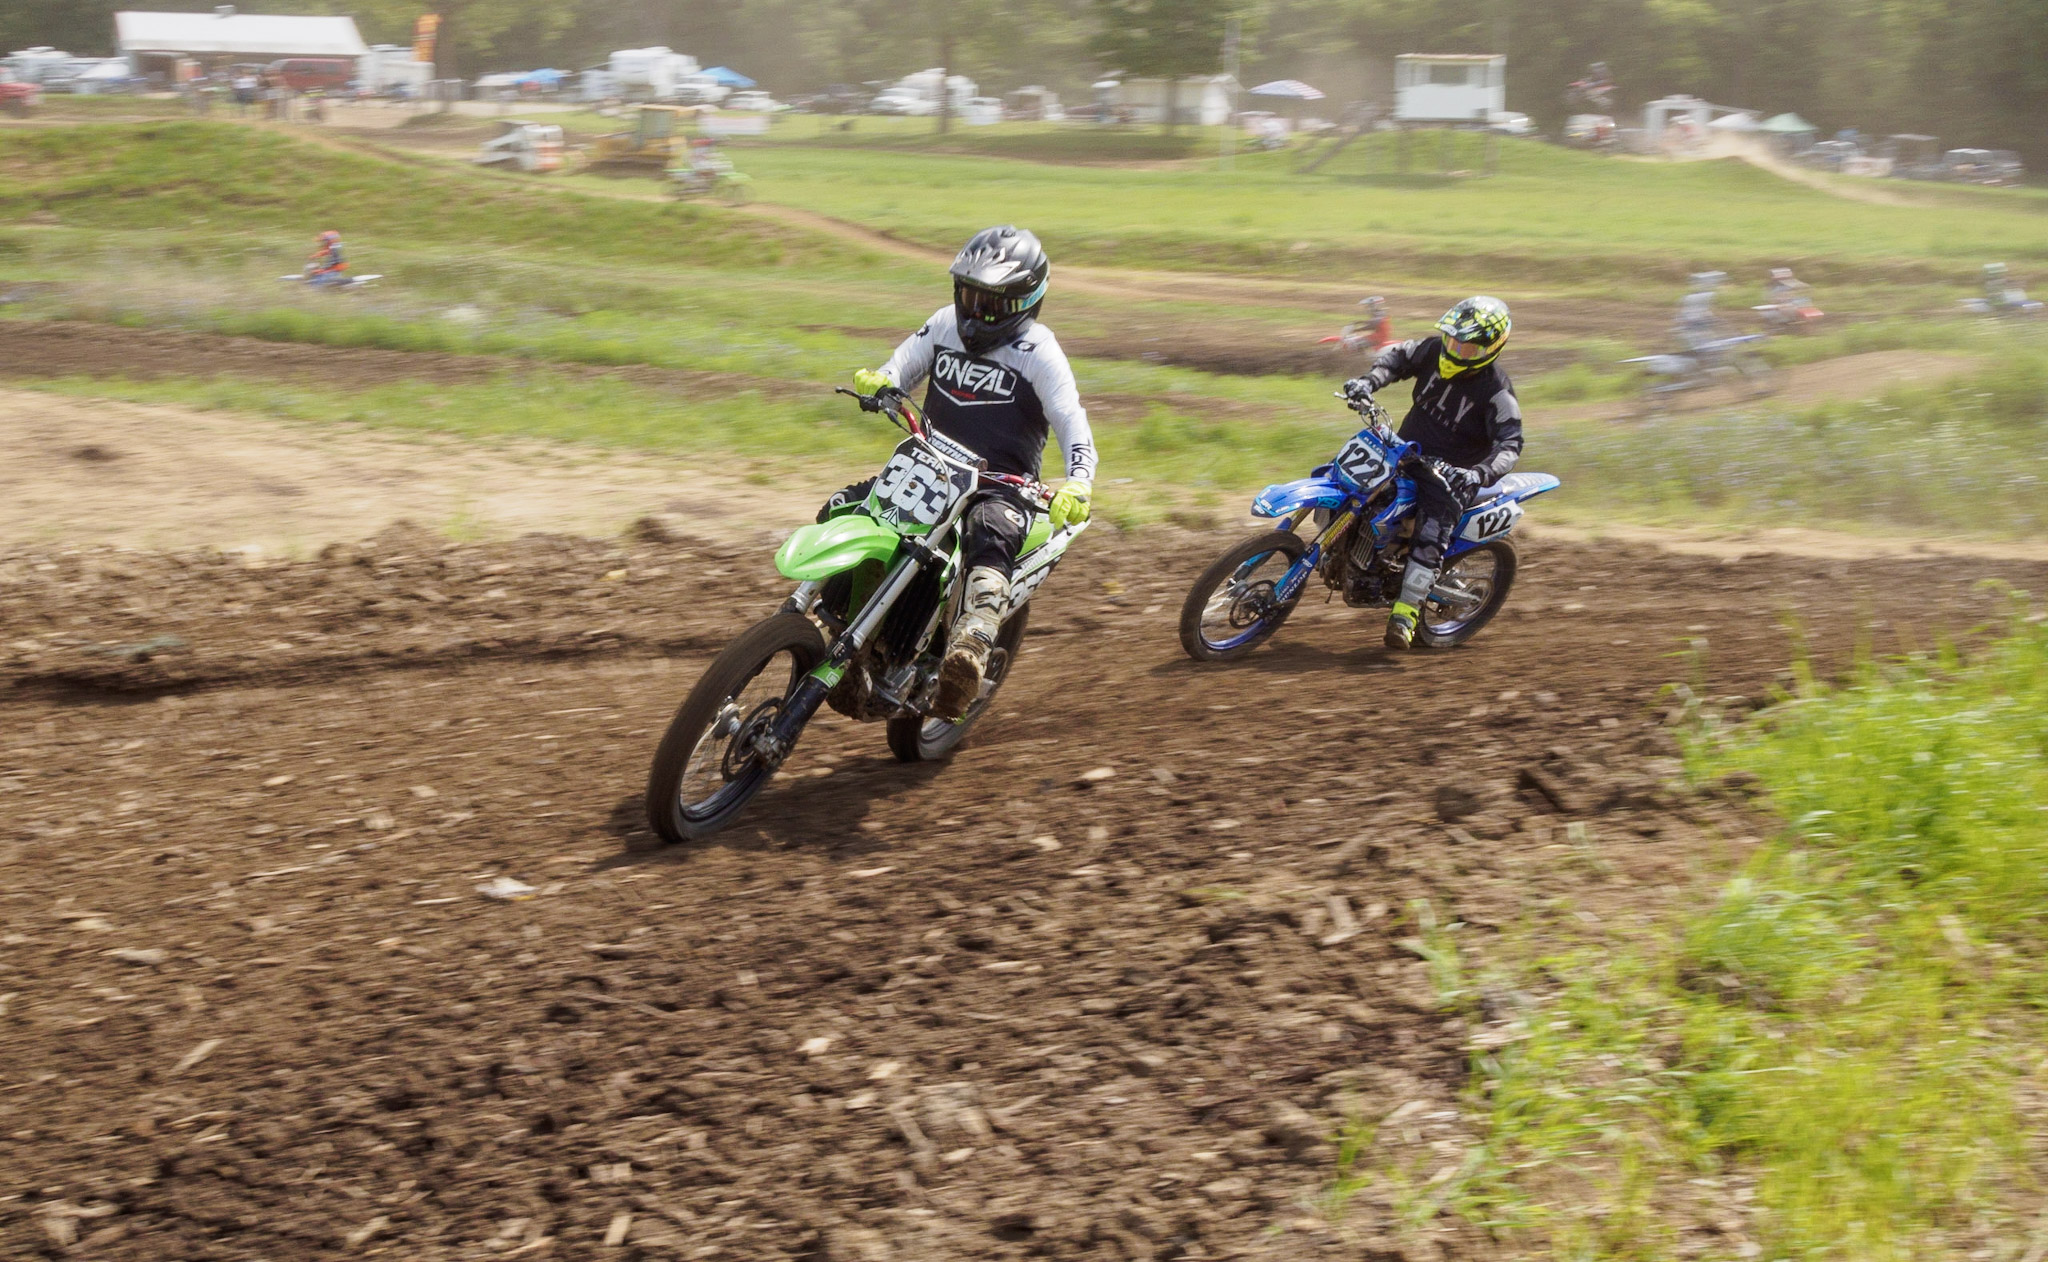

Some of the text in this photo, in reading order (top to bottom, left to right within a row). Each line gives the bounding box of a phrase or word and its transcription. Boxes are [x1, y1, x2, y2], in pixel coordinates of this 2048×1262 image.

[1421, 372, 1475, 424] FLY
[911, 447, 959, 478] TERRY
[1338, 443, 1386, 487] 122
[875, 453, 960, 525] 363
[1477, 507, 1512, 539] 122
